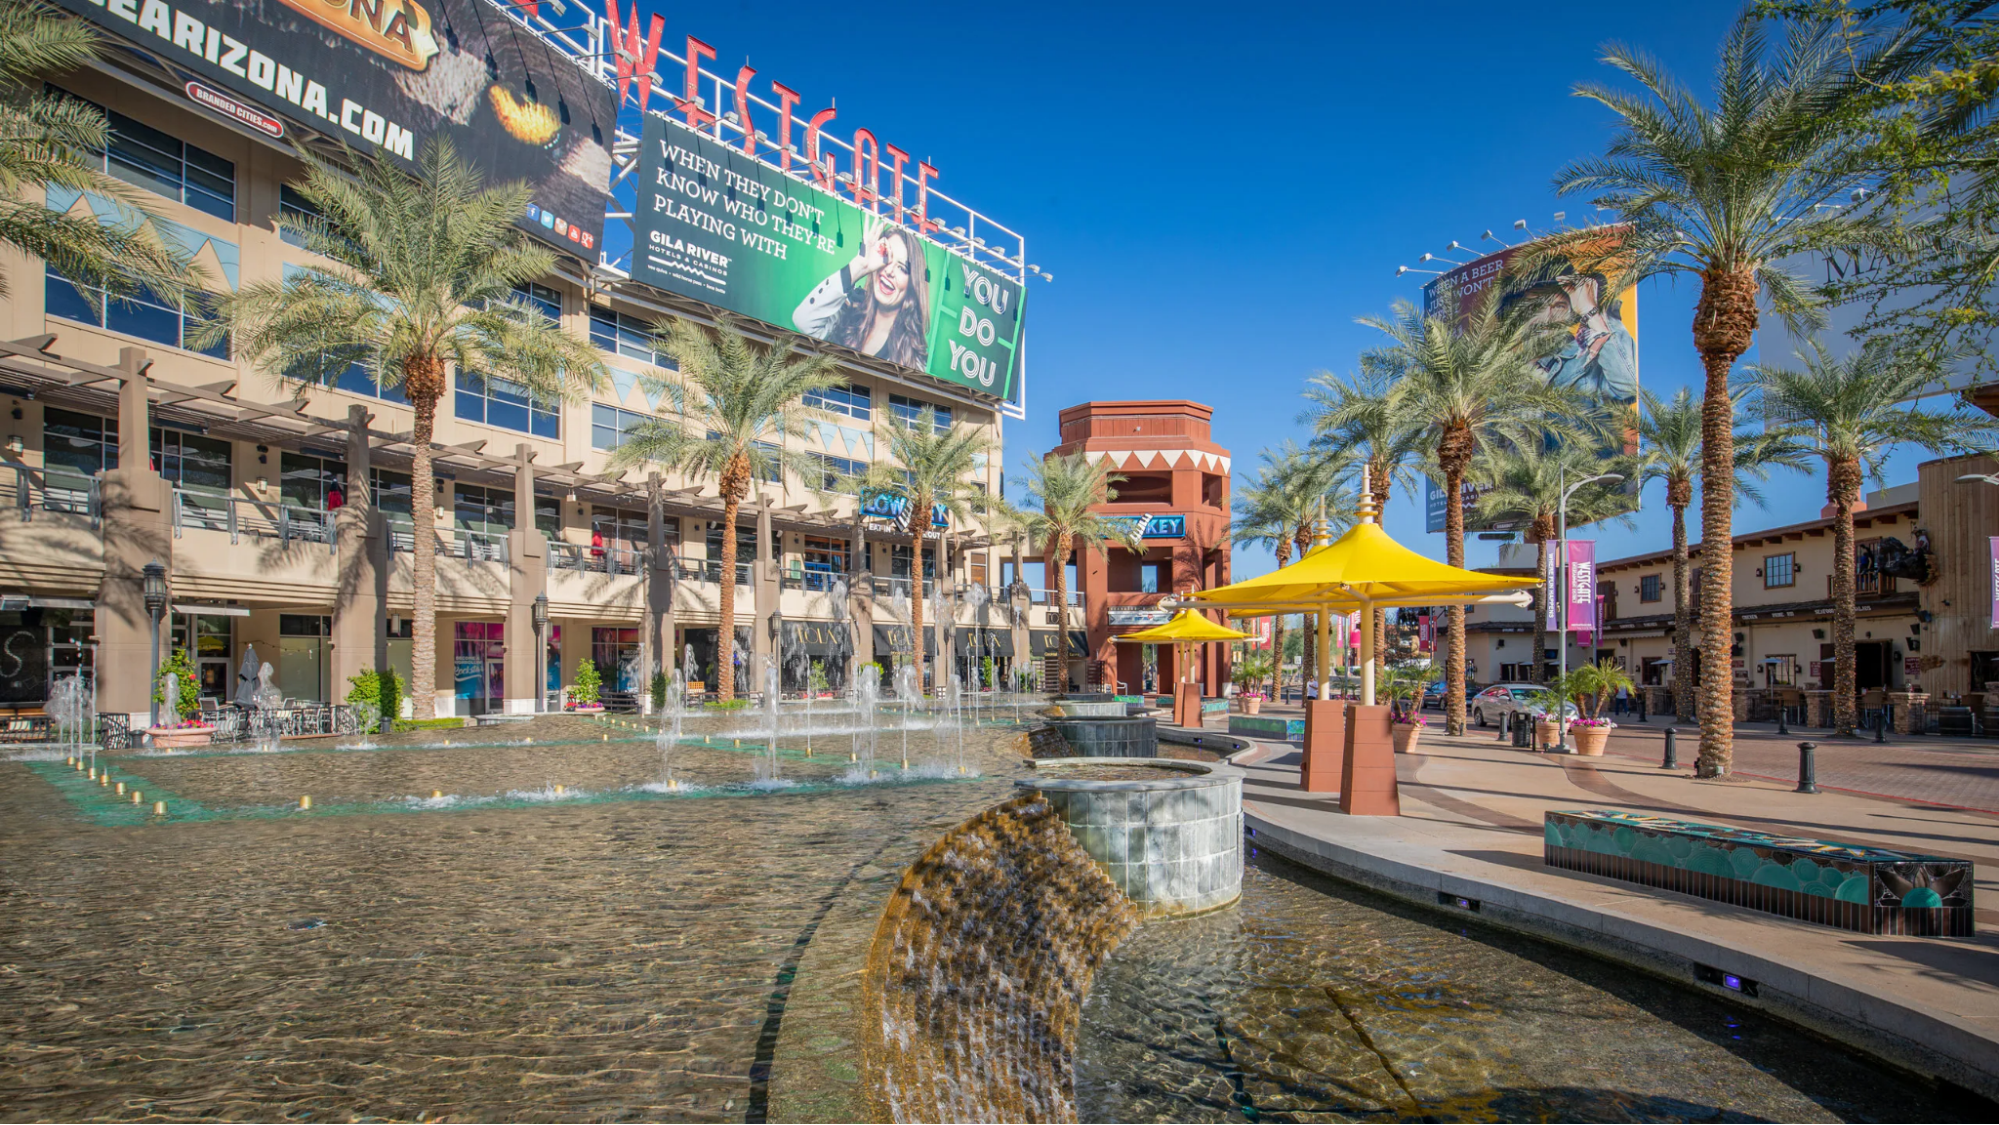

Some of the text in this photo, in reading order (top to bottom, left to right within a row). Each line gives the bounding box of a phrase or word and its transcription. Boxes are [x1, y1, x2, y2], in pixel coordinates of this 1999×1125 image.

[87, 0, 414, 161] EARIZONA.COM
[196, 88, 236, 114] BRANDED
[604, 0, 940, 235] WESTGATE
[660, 139, 824, 225] WHEN THEY DON'T
[654, 194, 788, 260] PLAYING WITH
[656, 166, 836, 255] KNOW WHO THEY'RE
[649, 244, 682, 260] HOTELS
[692, 260, 728, 276] CASINOS
[650, 230, 685, 252] GILA
[962, 263, 1009, 315] YOU
[1460, 271, 1469, 283] A
[1471, 259, 1504, 279] BEER
[959, 305, 995, 347] DO
[948, 339, 996, 387] YOU
[866, 494, 907, 515] LOW
[1430, 489, 1447, 500] GIL
[869, 523, 882, 531] EAT
[884, 525, 891, 533] IN
[1146, 518, 1182, 534] KEY
[1577, 561, 1591, 604] WESTGATE
